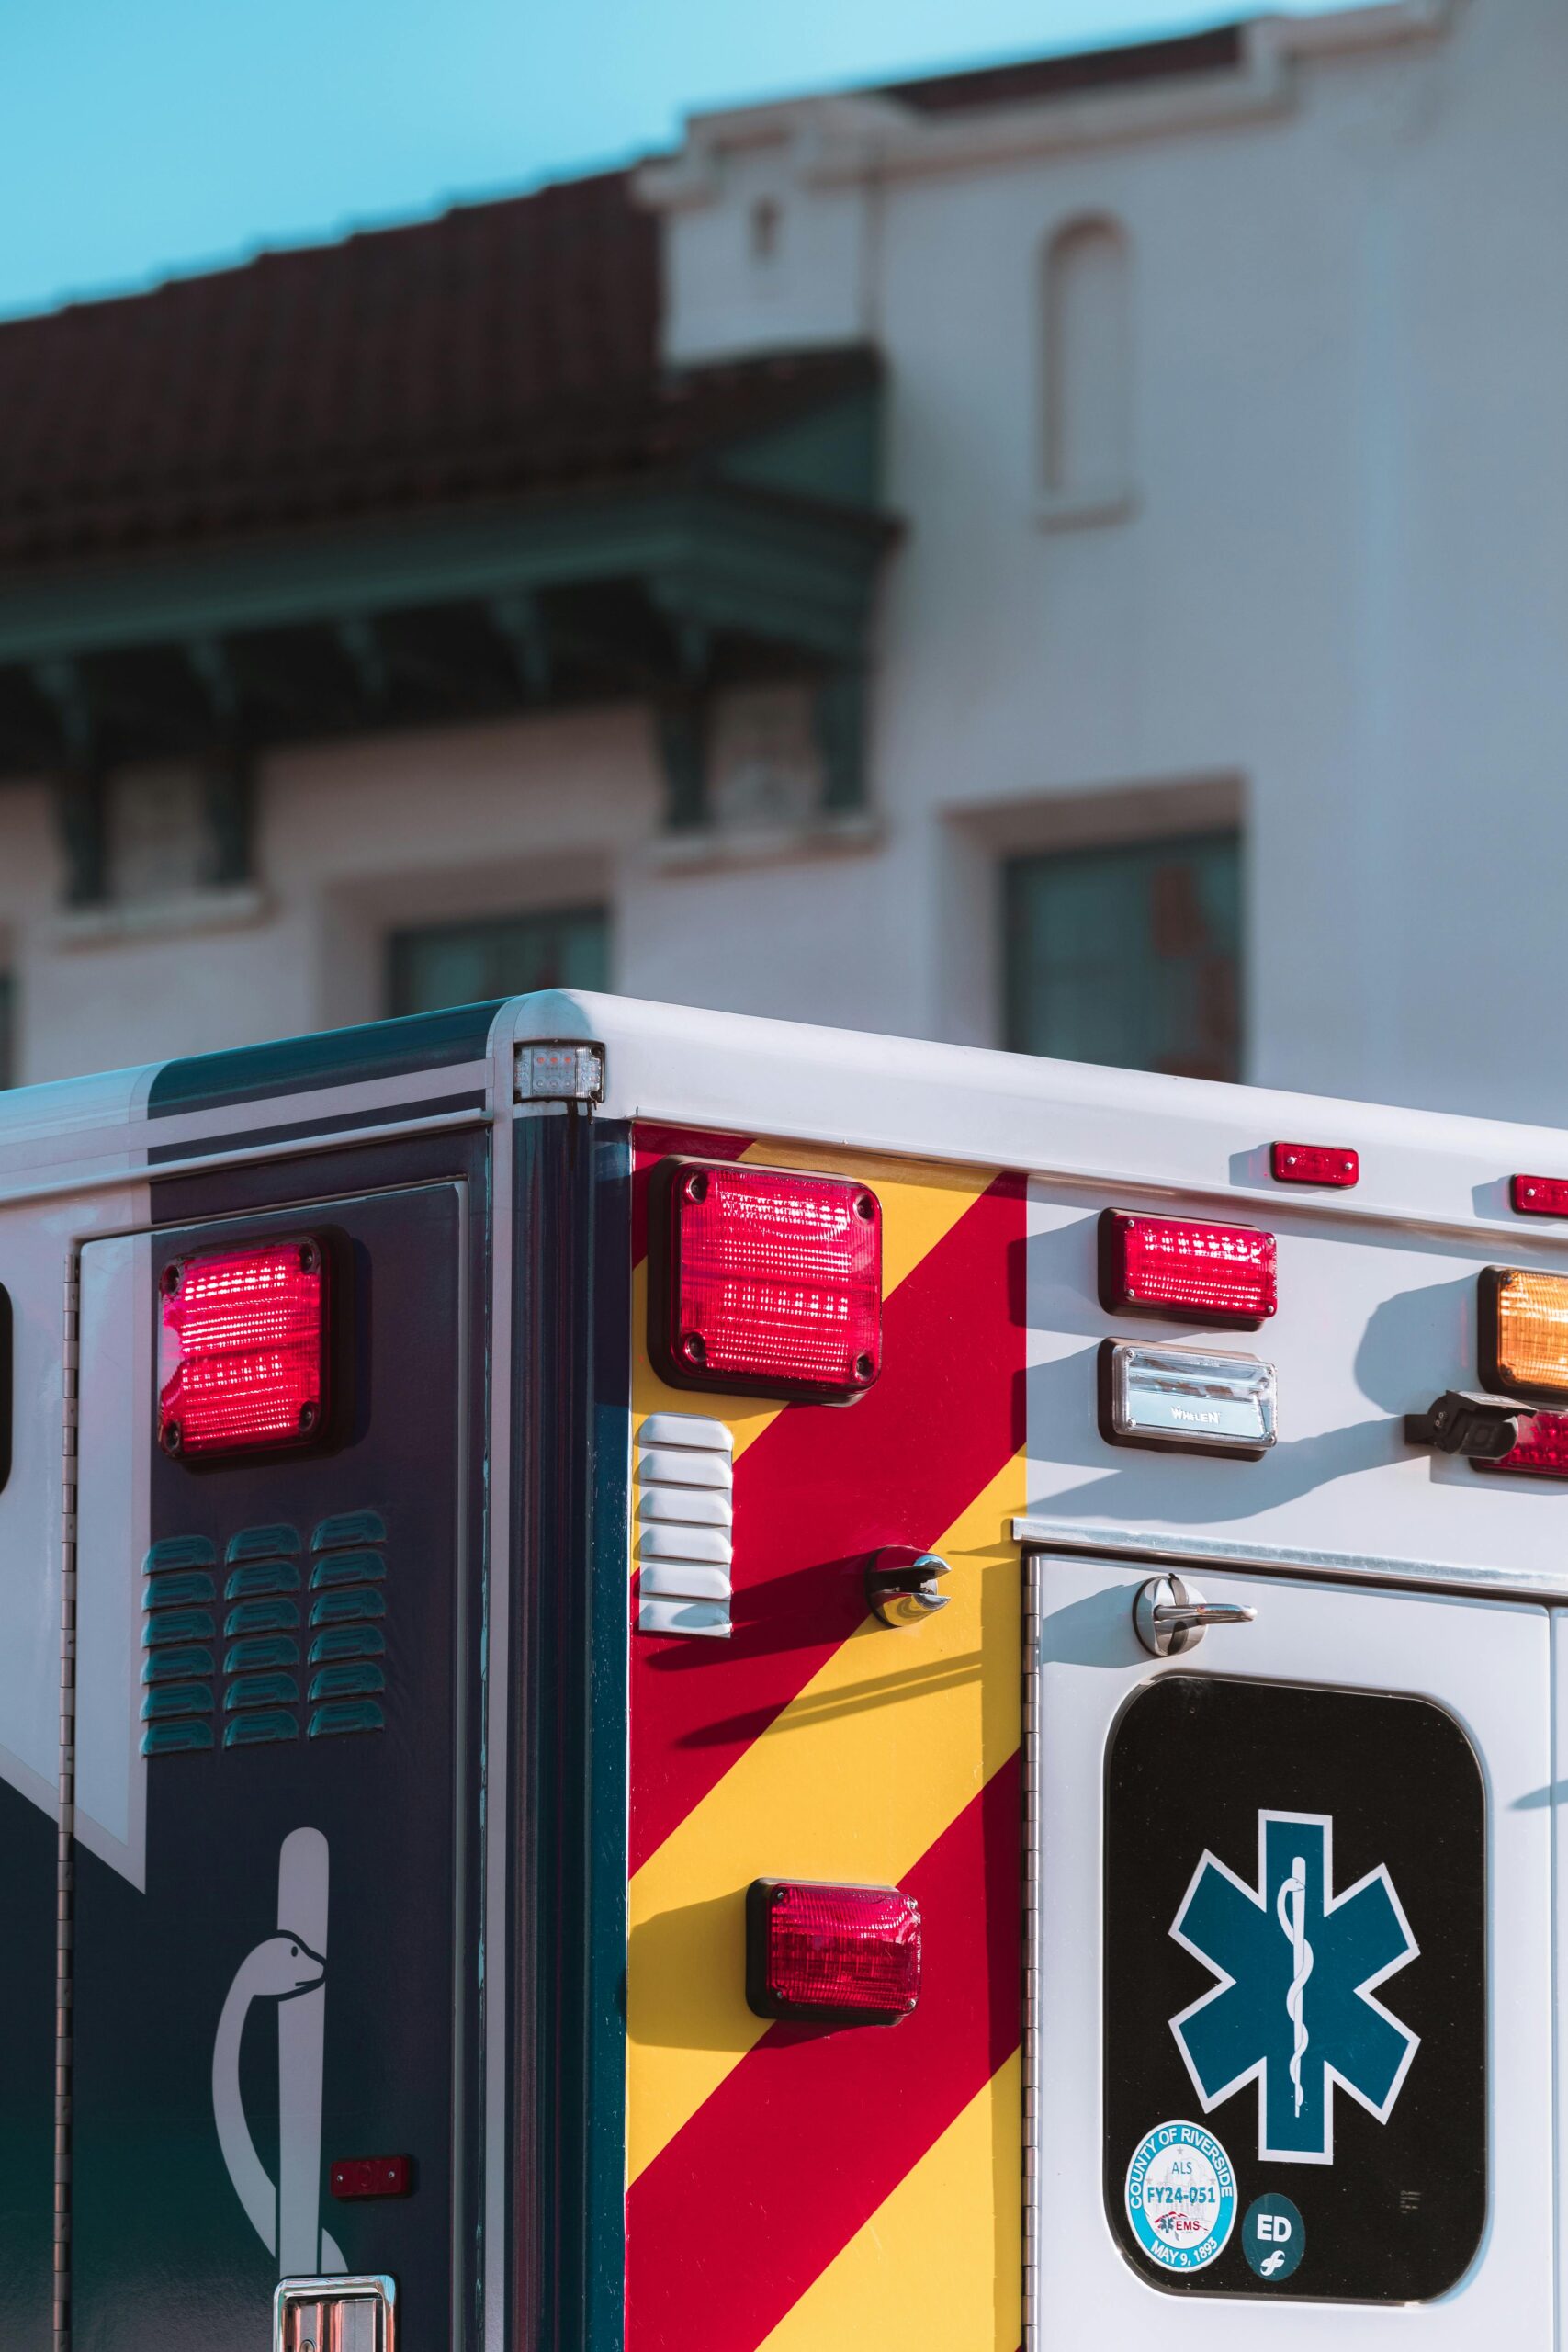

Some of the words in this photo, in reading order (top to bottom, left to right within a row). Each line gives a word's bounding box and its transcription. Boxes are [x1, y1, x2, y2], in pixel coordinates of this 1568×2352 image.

[1130, 2138, 1156, 2208] COUNTY
[1158, 2128, 1178, 2144] OF
[1181, 2128, 1232, 2197] RIVERSIDE
[1171, 2162, 1192, 2174] ALS
[1147, 2187, 1215, 2204] FY24-051
[1176, 2221, 1200, 2231] EMS
[1257, 2214, 1292, 2242] ED
[1150, 2240, 1179, 2266] MAY
[1181, 2253, 1191, 2266] 9,
[1194, 2237, 1218, 2262] 1893
